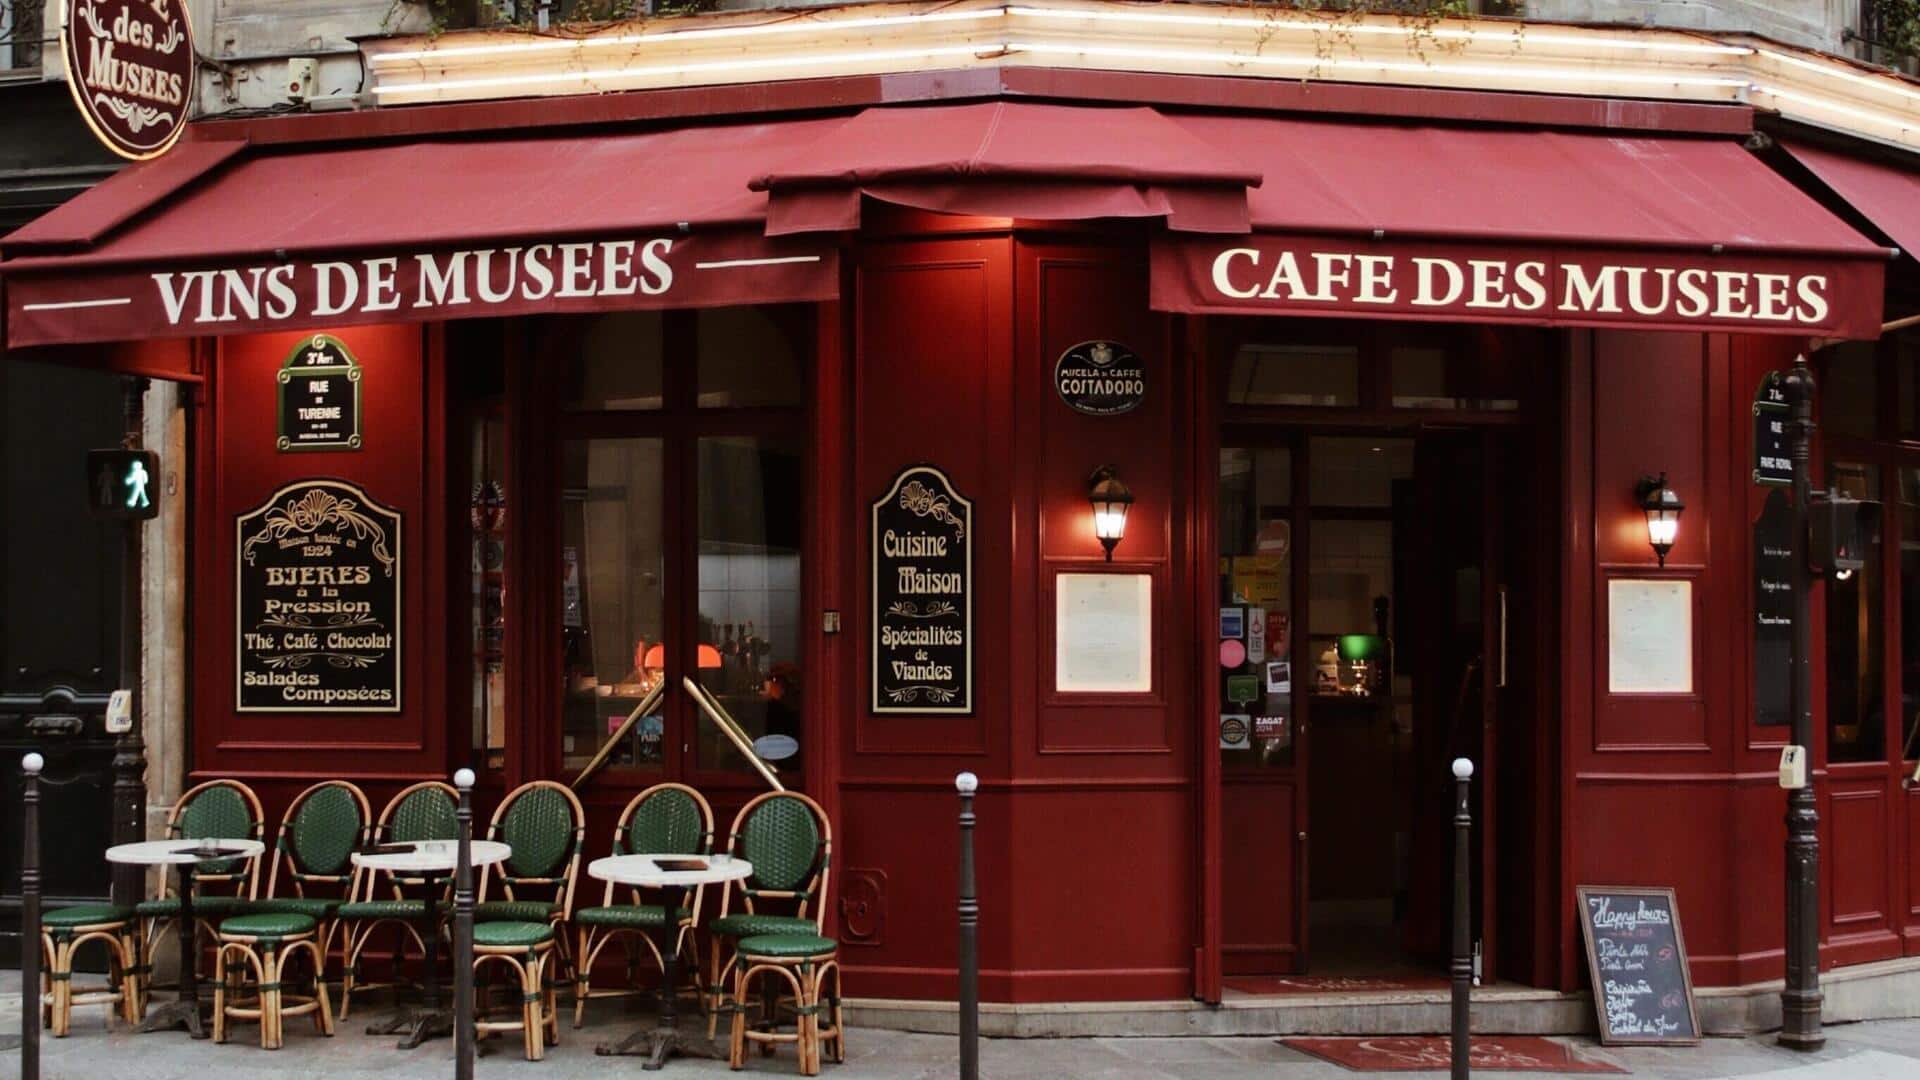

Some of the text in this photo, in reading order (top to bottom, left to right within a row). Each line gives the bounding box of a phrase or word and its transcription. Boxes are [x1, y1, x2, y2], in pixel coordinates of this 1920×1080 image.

[114, 6, 153, 47] des
[87, 36, 183, 106] MUSEES
[151, 238, 674, 325] VINS DE MUSEES
[1211, 248, 1830, 323] CAFE DES MUSEES
[309, 381, 329, 393] RUE
[1061, 379, 1143, 395] COSTADORO
[298, 407, 341, 420] TURENNE
[303, 545, 333, 556] 1924
[883, 529, 947, 557] Cuisine
[898, 566, 962, 594] Maison
[322, 586, 339, 597] la
[265, 599, 371, 613] Pression
[327, 632, 392, 649] Chocolat
[882, 625, 962, 650] Spécialités
[915, 649, 928, 660] de
[244, 671, 320, 686] Salades
[892, 661, 952, 681] Viandes
[282, 686, 392, 703] Composées
[1256, 717, 1284, 725] ZAGAT
[1589, 897, 1636, 929] Happy
